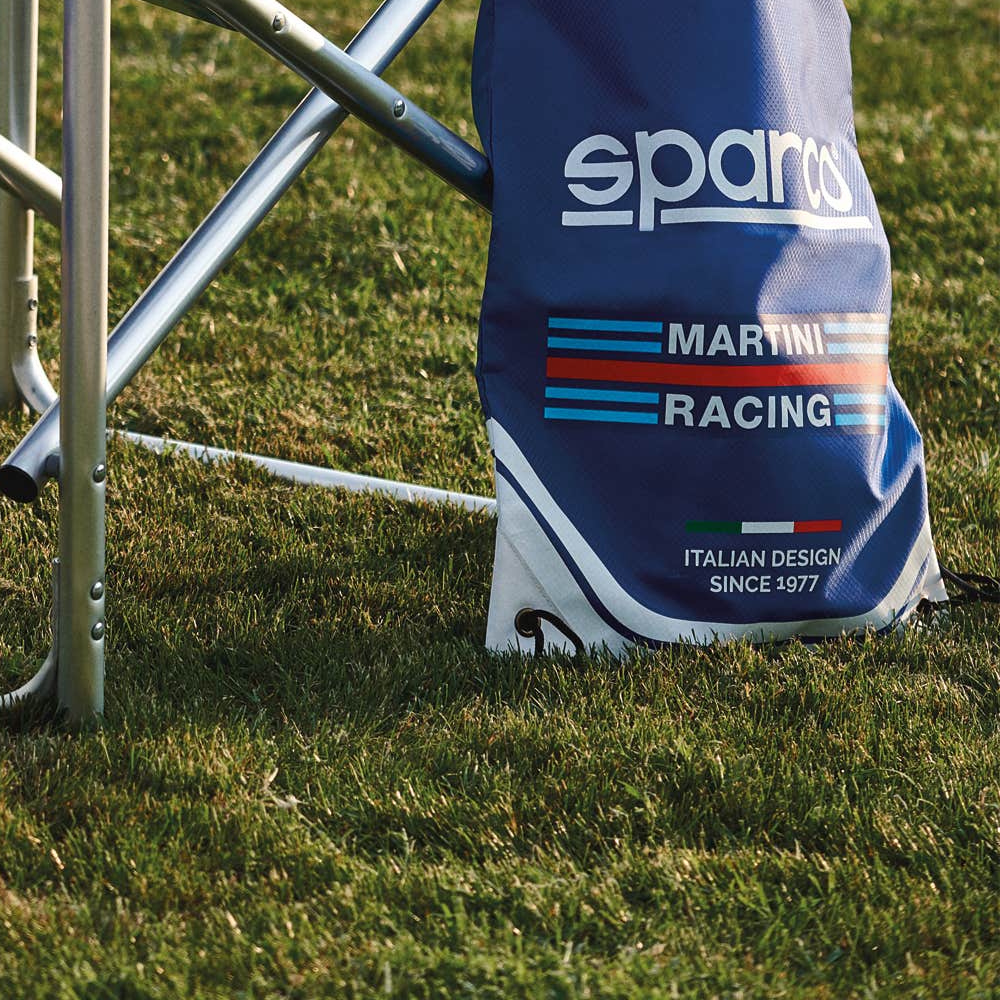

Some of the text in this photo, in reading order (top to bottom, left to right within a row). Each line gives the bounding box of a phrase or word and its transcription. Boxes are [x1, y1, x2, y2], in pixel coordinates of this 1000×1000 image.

[562, 128, 866, 232] sparco
[667, 322, 825, 357] MARTINI
[664, 393, 832, 430] RACING
[684, 547, 842, 568] ITALIAN DESIGN
[709, 574, 820, 593] SINCE 1977
